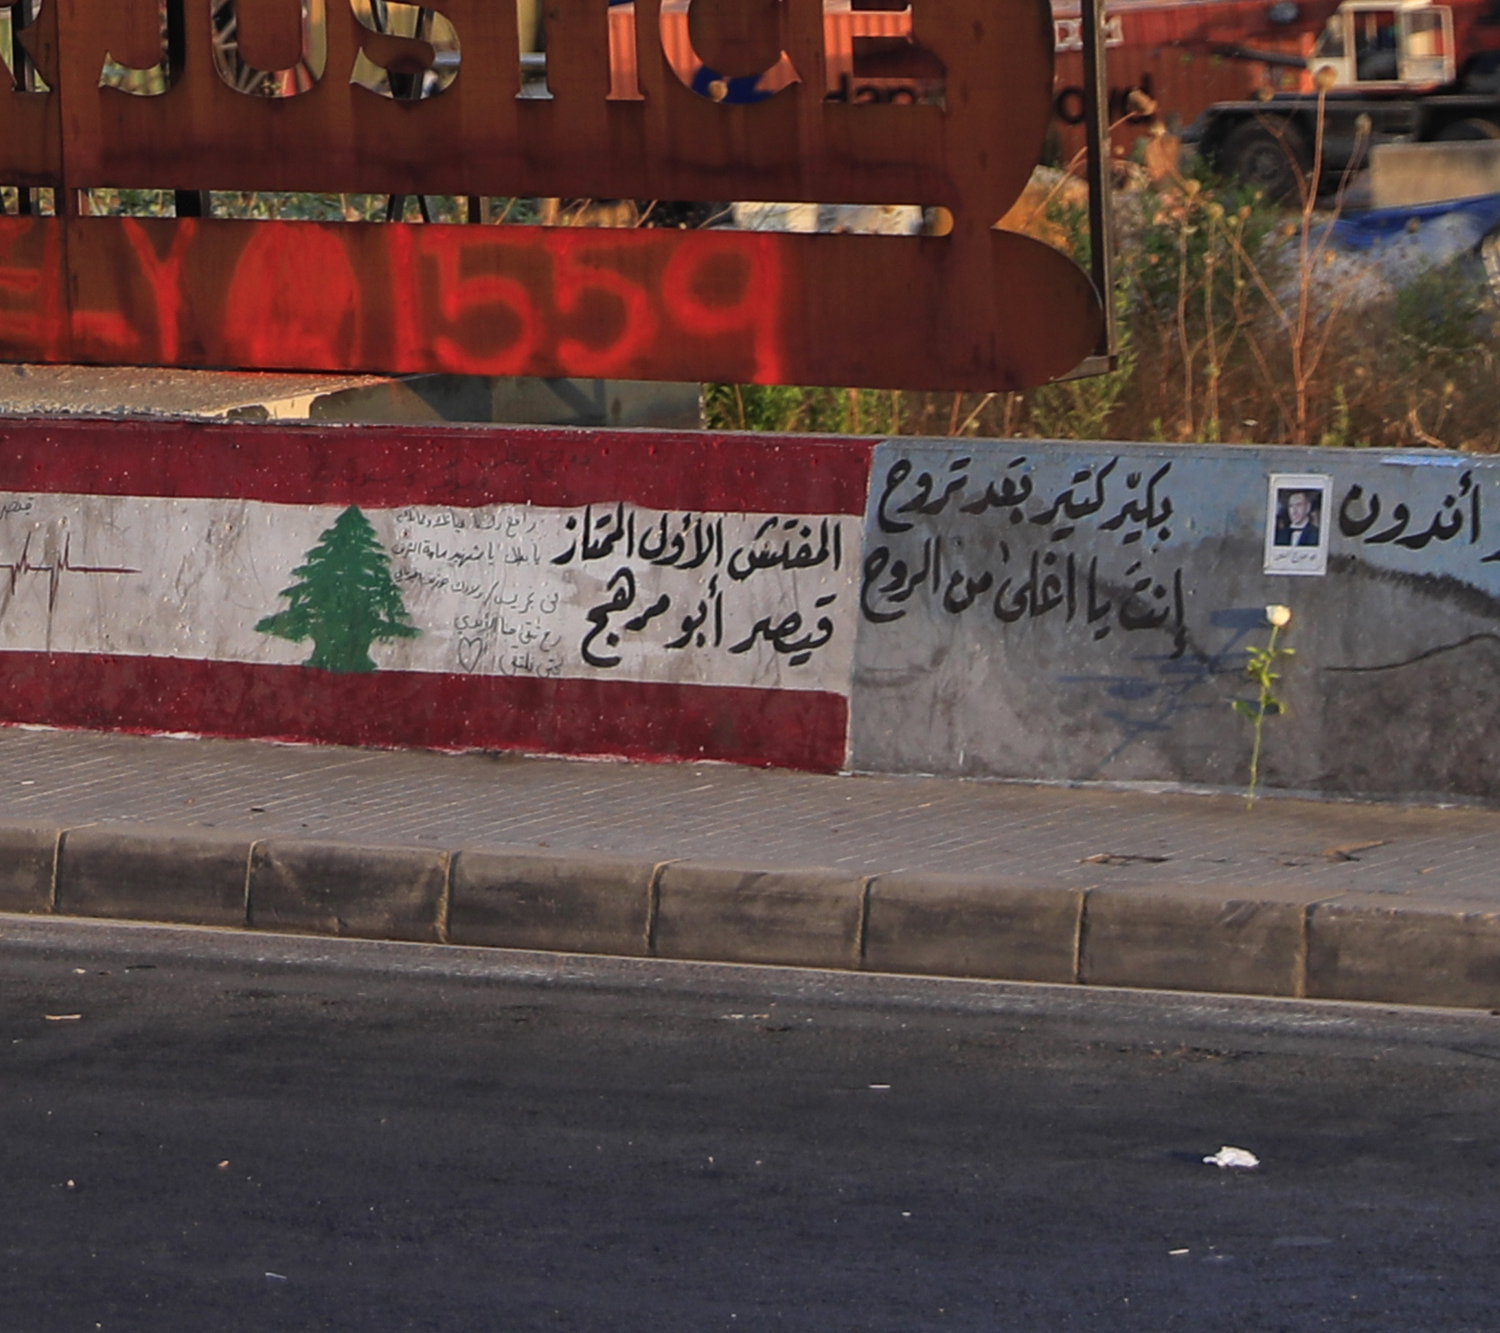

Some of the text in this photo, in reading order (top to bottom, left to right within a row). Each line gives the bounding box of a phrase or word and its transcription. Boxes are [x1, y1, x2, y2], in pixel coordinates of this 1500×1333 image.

[550, 502, 636, 565] الممتاز
[727, 515, 842, 581] المفتش
[664, 573, 724, 649] أبو
[860, 535, 942, 624] الروح
[942, 569, 994, 614] من
[580, 566, 672, 669] مرهج
[727, 593, 838, 667] قيصر
